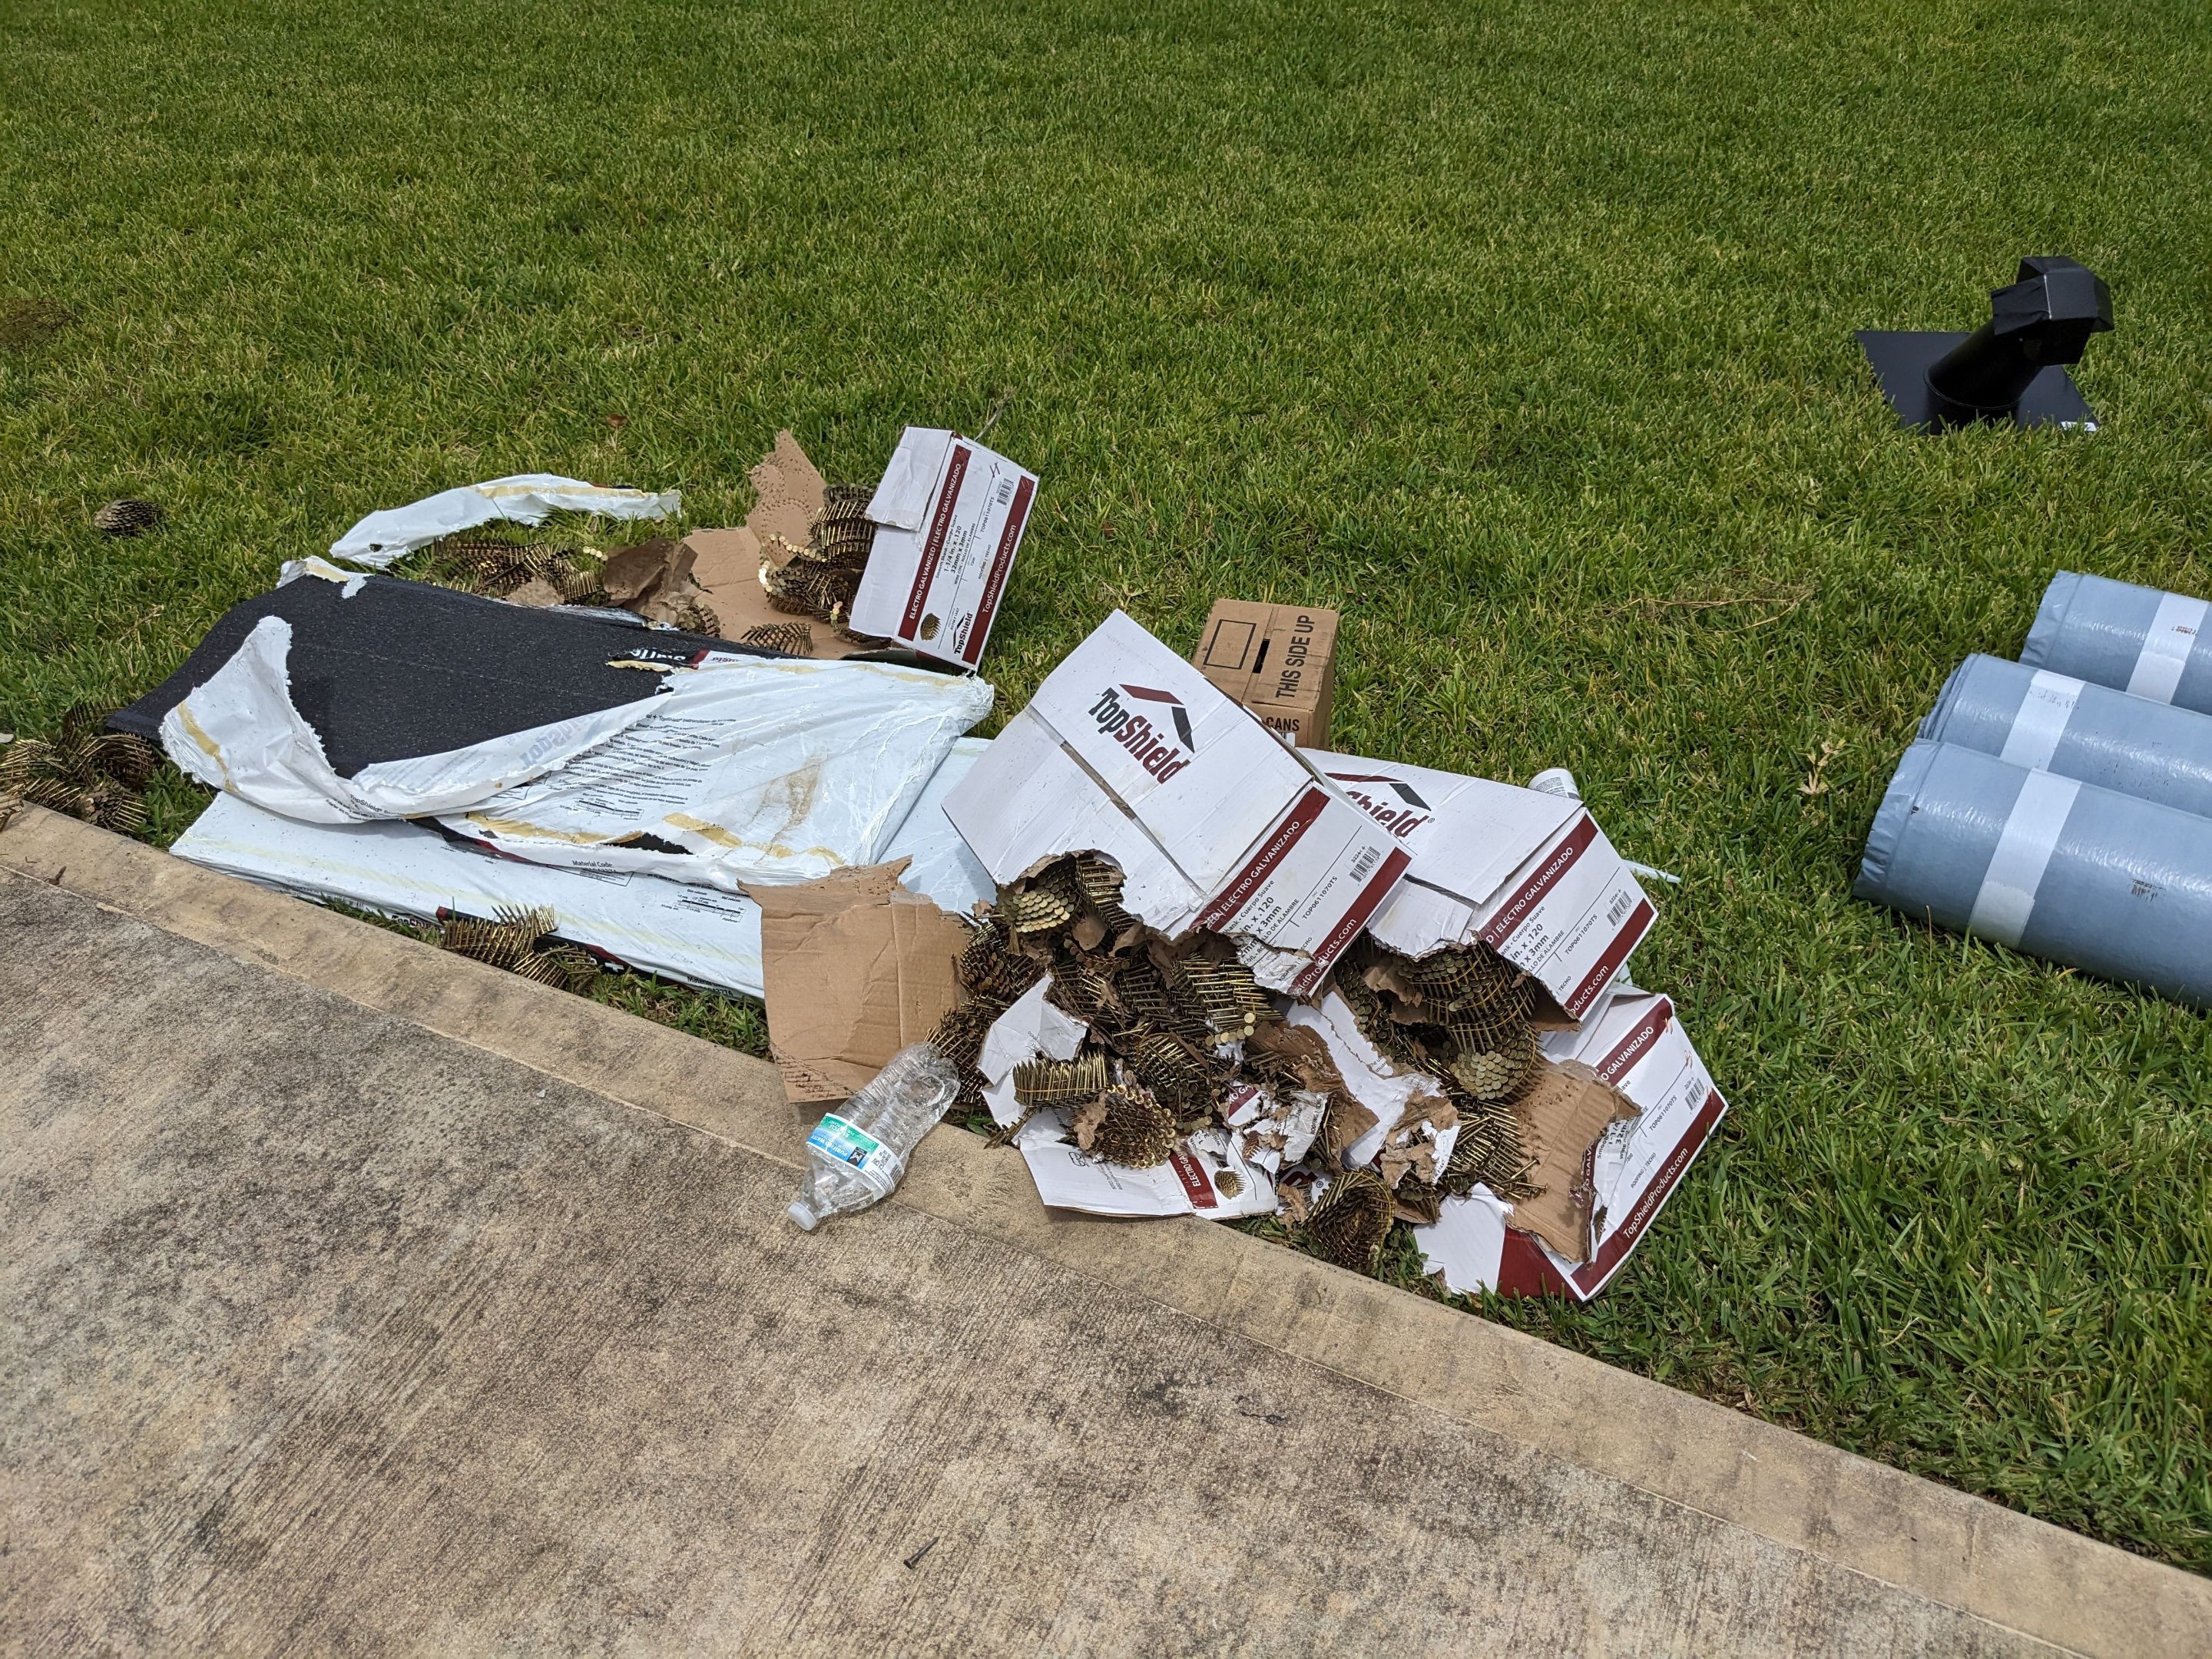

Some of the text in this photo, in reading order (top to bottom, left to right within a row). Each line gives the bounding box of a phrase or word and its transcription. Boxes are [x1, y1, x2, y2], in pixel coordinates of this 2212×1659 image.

[909, 464, 961, 618] ELECTRO GALVANIZED ELECTRO GALVANIZADO
[953, 525, 962, 539] .120
[951, 553, 960, 572] 32mm
[983, 526, 1015, 611] TopShieldProducts.com
[1276, 615, 1314, 697] THIS SIDE UP
[1088, 687, 1191, 784] TopShield
[1267, 717, 1300, 732] CANS
[1222, 876, 1252, 912] ELECTRO
[1251, 821, 1299, 878] GALVANIZADO
[1240, 896, 1259, 918] Cuerpo
[1257, 879, 1273, 897] Suave
[1256, 896, 1273, 916] .120
[1302, 876, 1337, 918] TOP0611070TS
[1496, 899, 1525, 932] ELECTRO
[1525, 846, 1572, 900] GALVANIZADO
[1255, 926, 1263, 934] x
[1260, 904, 1280, 927] 3mm
[1270, 922, 1278, 931] DE
[1277, 898, 1298, 924] ALAMBRE
[1512, 922, 1531, 942] Cuerpo
[1529, 905, 1545, 922] Suave
[1509, 947, 1522, 960] in.
[1525, 923, 1543, 942] .120
[1528, 934, 1548, 956] 3mm
[1536, 952, 1545, 962] DE
[1543, 930, 1564, 954] ALAMBRE
[1565, 915, 1597, 953] TOP0611070TS
[1608, 1022, 1653, 1077] GALVANIZADO
[1183, 1160, 1200, 1187] ELECTRO
[1623, 1151, 1690, 1235] TopShieldProducts.com
